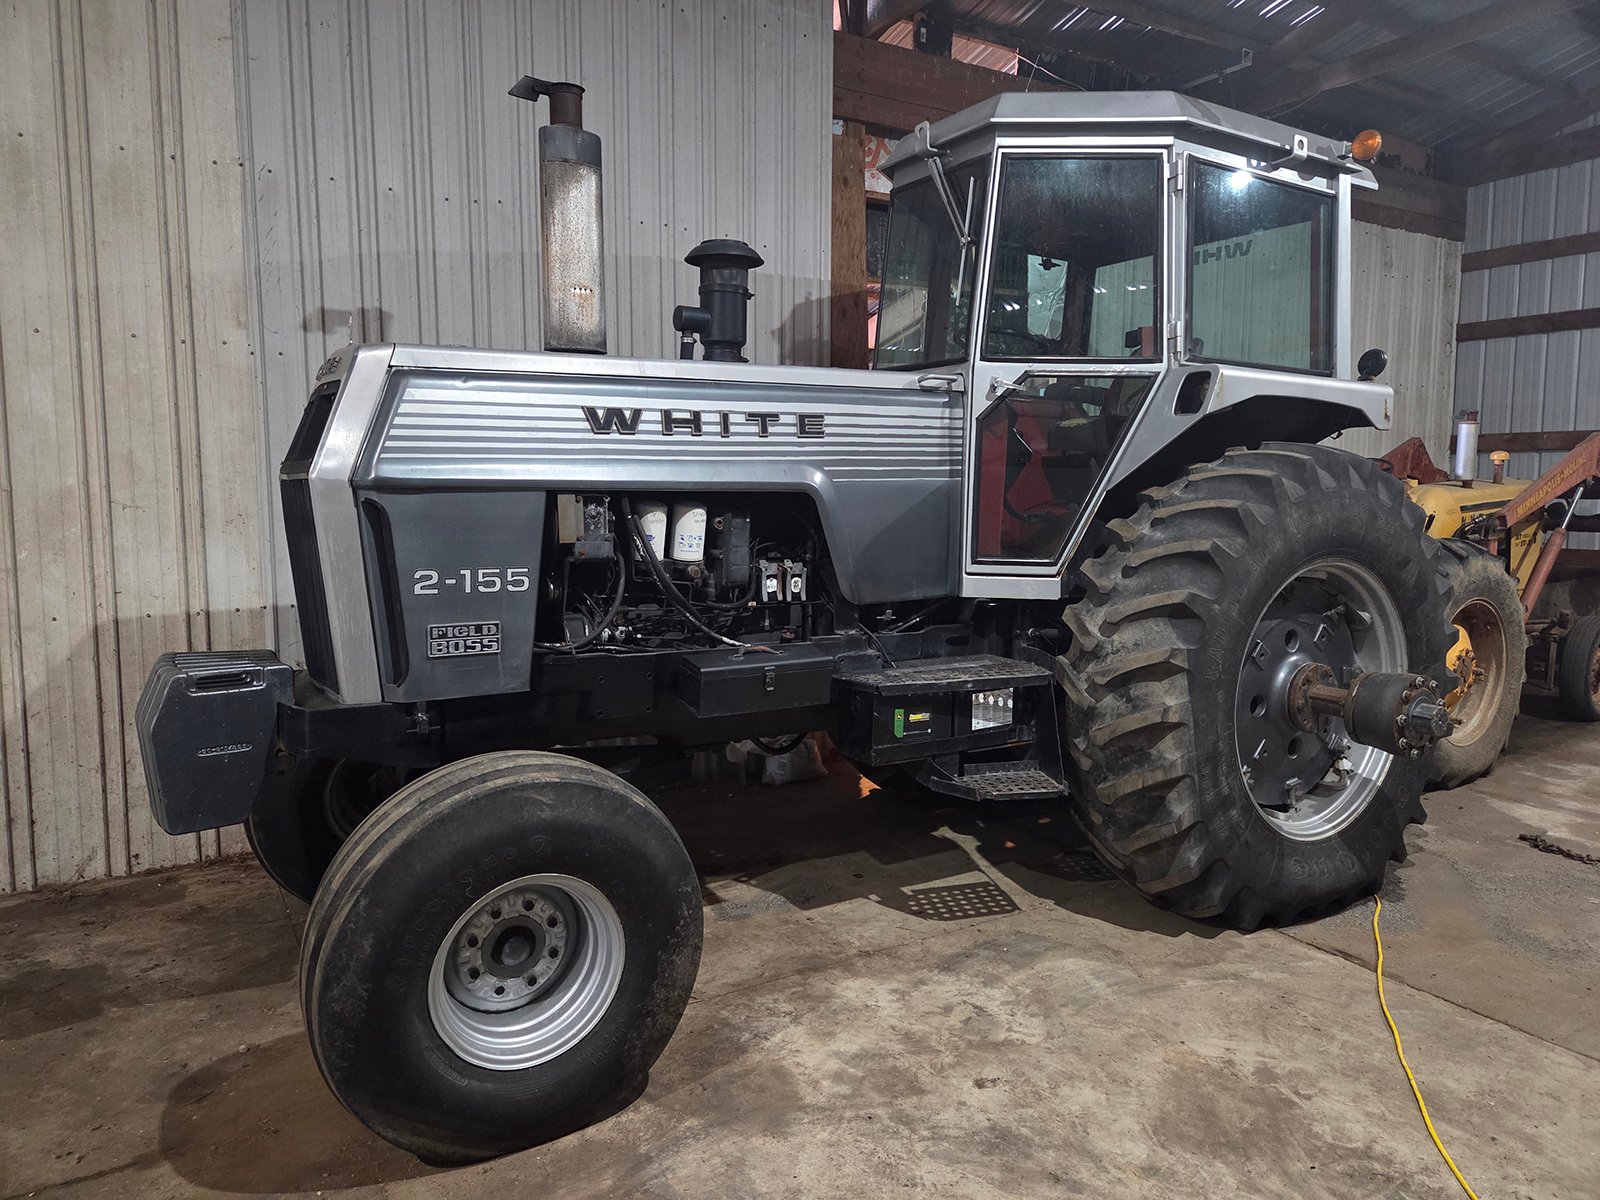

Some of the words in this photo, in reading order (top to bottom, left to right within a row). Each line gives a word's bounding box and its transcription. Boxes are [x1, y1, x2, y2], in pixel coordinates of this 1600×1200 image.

[581, 405, 826, 439] WHITE
[1516, 454, 1587, 518] MINNEAPOLIS-MOLINE
[412, 566, 531, 596] 2-155
[431, 624, 498, 639] FIELD
[431, 638, 498, 655] BOSS
